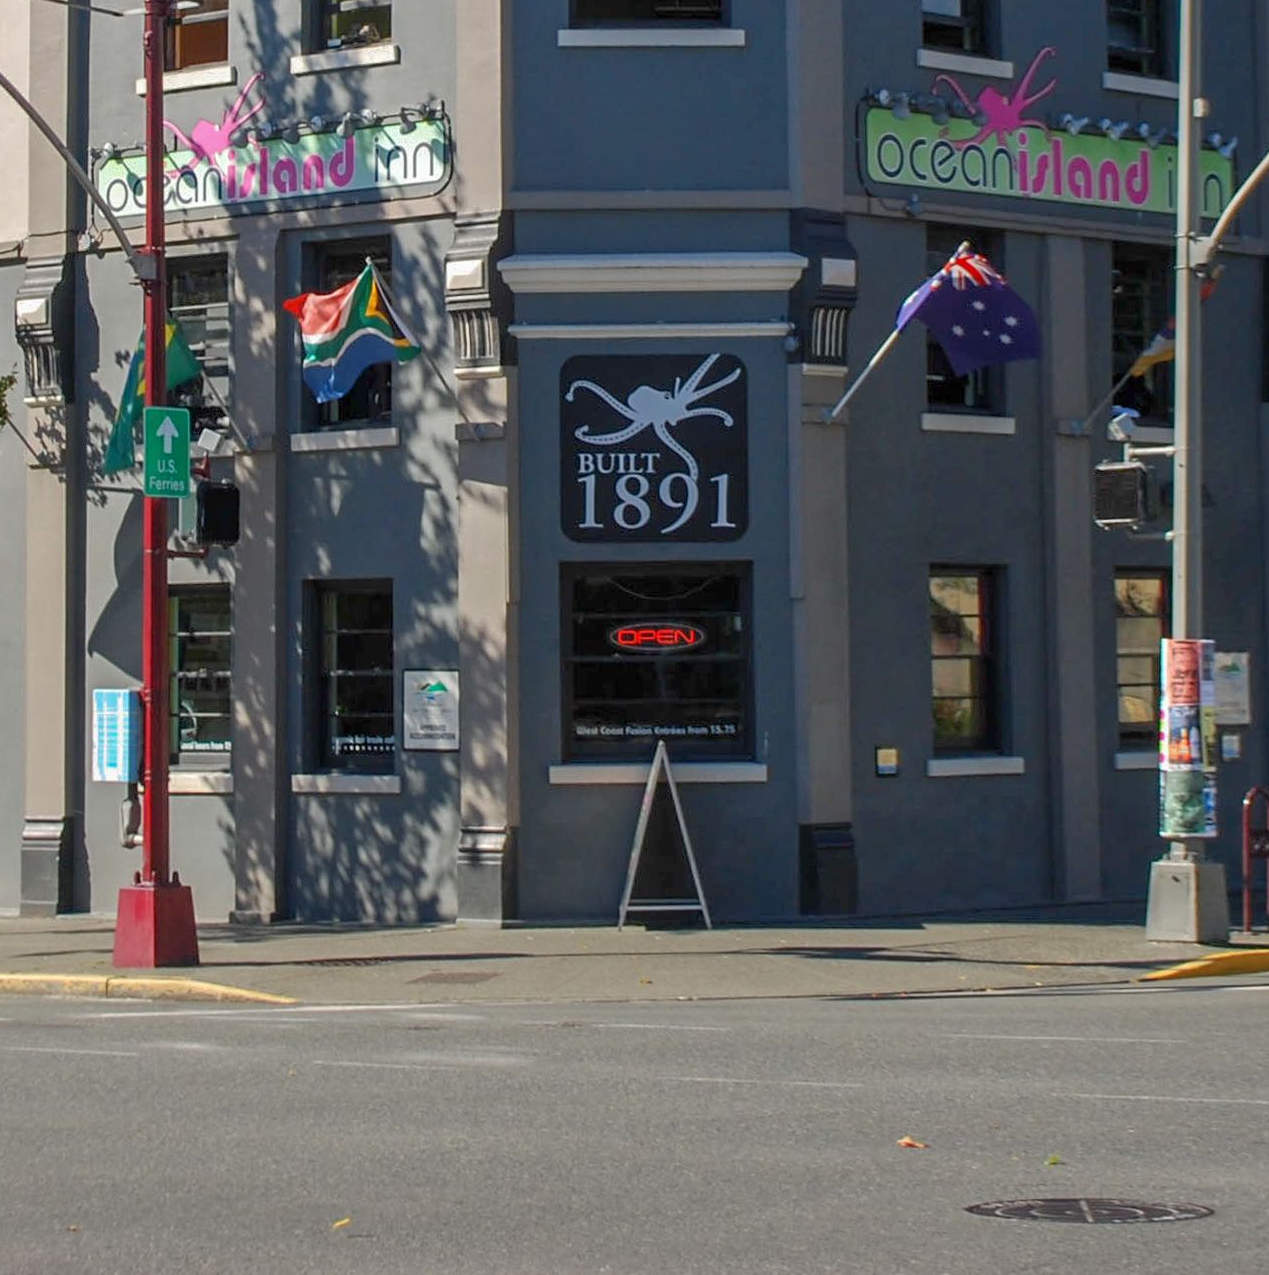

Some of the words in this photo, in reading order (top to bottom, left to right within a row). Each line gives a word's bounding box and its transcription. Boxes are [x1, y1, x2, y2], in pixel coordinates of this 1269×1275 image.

[227, 136, 356, 202] island
[374, 136, 435, 183] inn
[876, 133, 1015, 191] ocean
[1018, 131, 1151, 205] island
[1167, 156, 1224, 213] in
[157, 459, 177, 474] U.S.
[577, 452, 661, 474] BUILT
[148, 477, 185, 492] Ferries
[577, 473, 737, 534] 1891
[616, 628, 696, 646] OPEN
